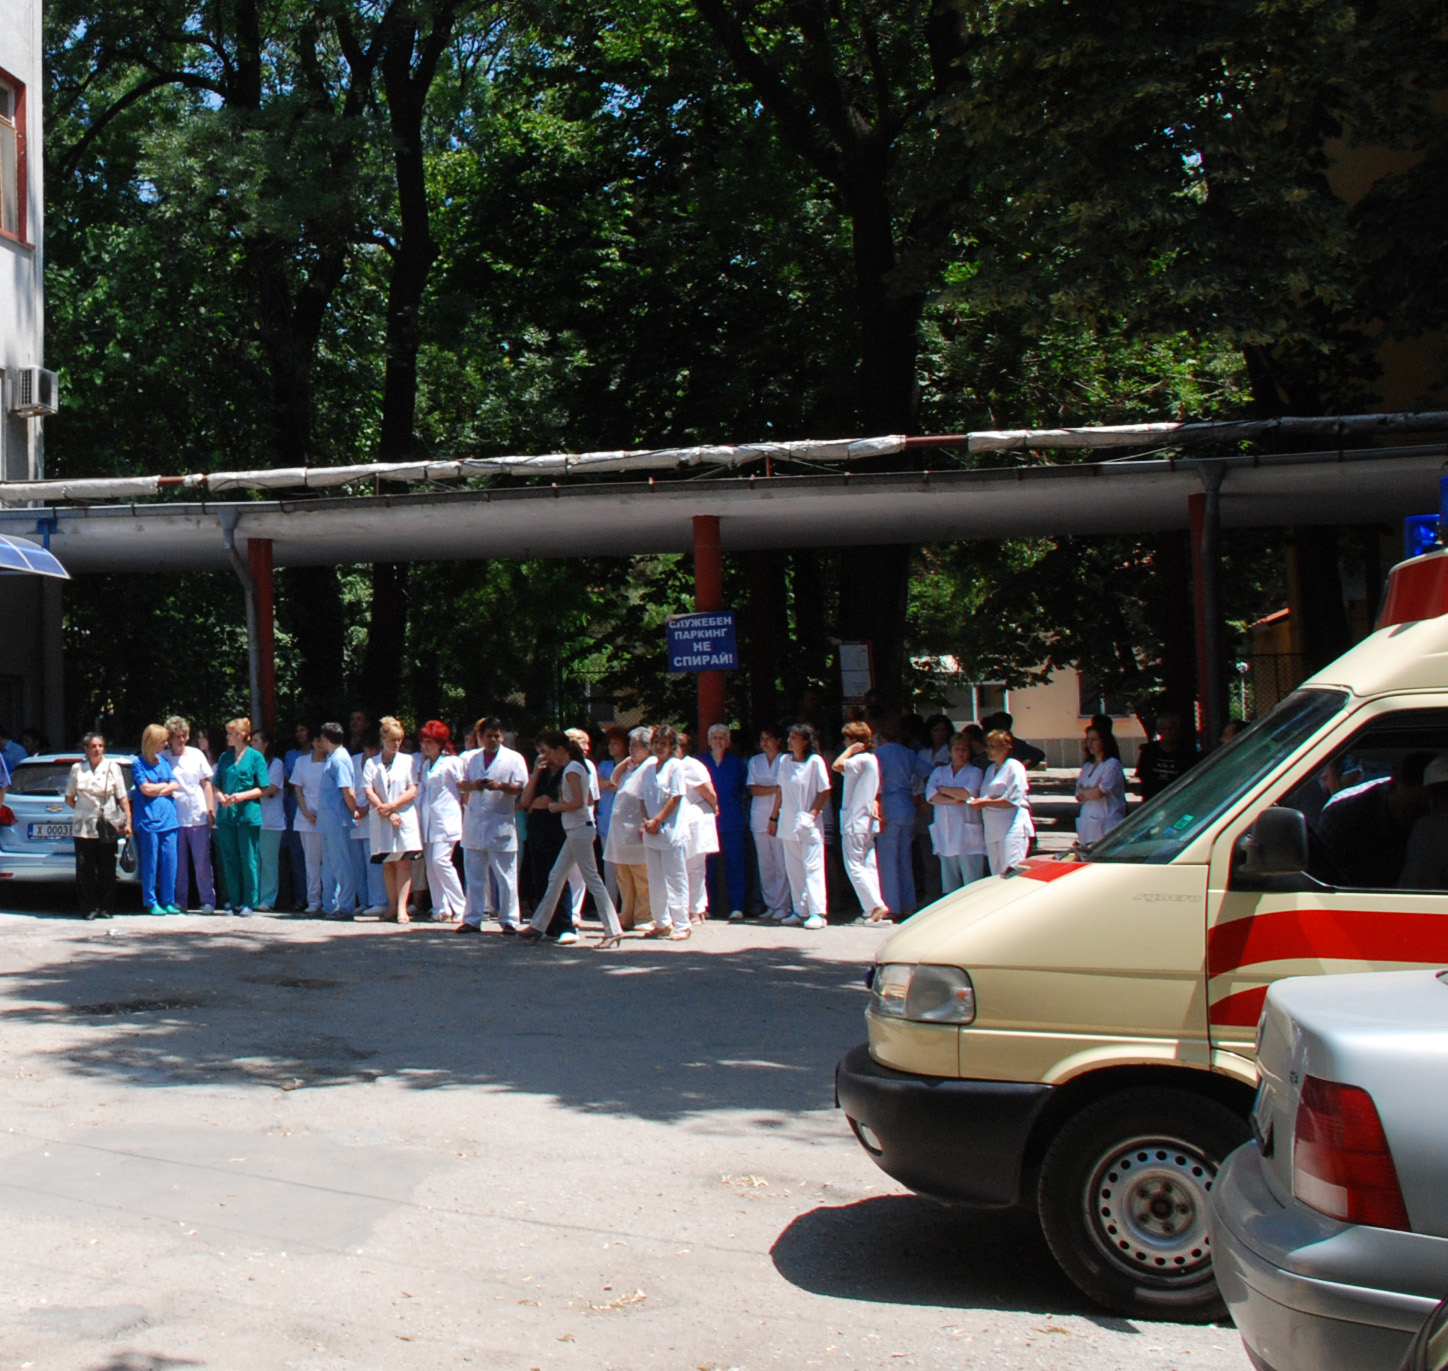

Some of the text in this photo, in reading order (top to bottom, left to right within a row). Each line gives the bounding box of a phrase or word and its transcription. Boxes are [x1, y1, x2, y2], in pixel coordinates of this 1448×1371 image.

[668, 616, 732, 629] СЛУЖЕБЕН
[674, 628, 728, 640] ПАРКИНГ
[692, 641, 712, 652] НЕ
[673, 651, 733, 667] СПИРАЙ!
